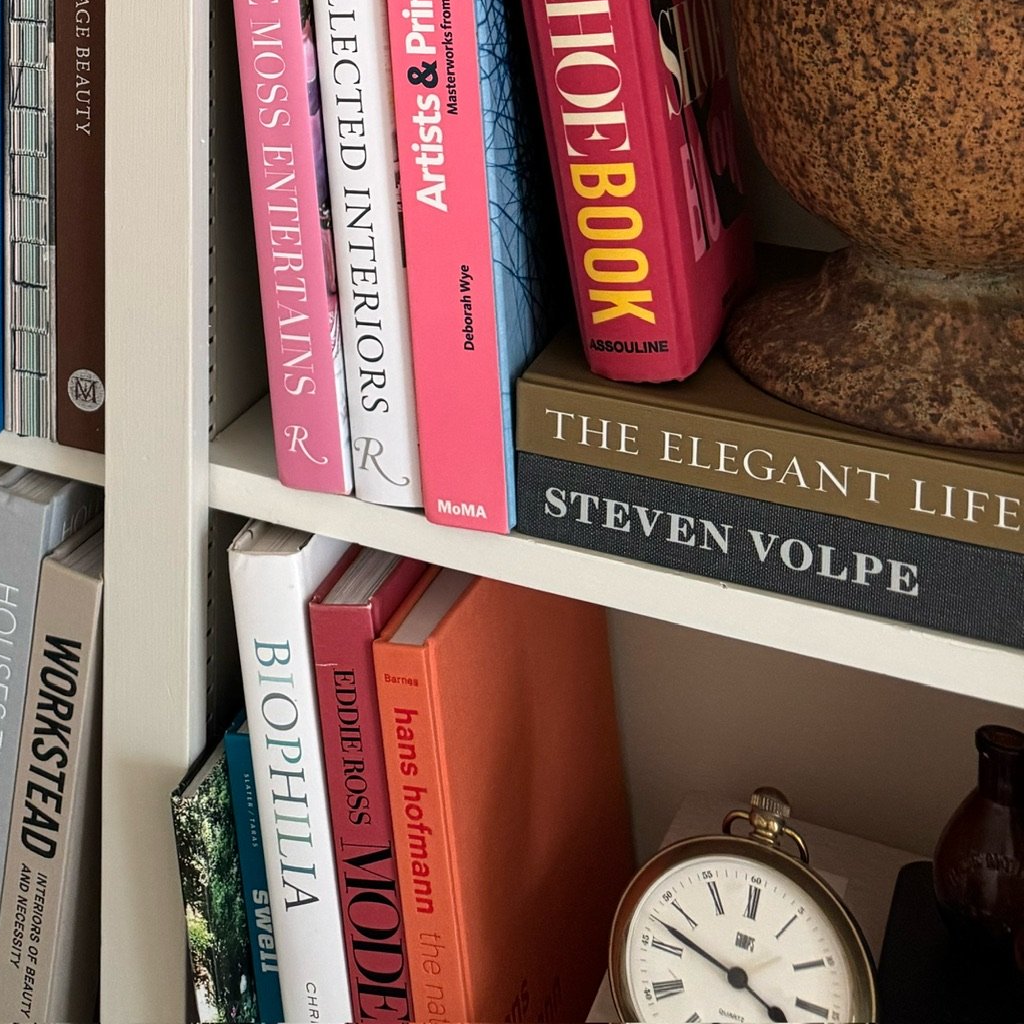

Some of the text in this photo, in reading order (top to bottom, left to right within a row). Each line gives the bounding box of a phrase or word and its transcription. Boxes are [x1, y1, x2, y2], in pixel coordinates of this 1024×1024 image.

[75, 46, 92, 136] BEAUTY
[249, 18, 292, 130] MOSS
[407, 59, 439, 89] &
[440, 31, 459, 116] Masterworks
[410, 92, 449, 213] Artists
[261, 143, 318, 397] ENTERTAINS
[569, 162, 657, 325] BOOK
[342, 186, 390, 415] INTERIORS
[459, 264, 475, 351] Deborah Wye
[589, 339, 669, 354] ASSOULINE
[437, 498, 487, 519] MoMA
[545, 408, 1021, 532] THE ELEGANT LIFE
[543, 486, 920, 597] STEVEN VOLPE
[383, 672, 419, 688] Barnes
[21, 634, 82, 860] WORKSTEAD
[243, 772, 254, 808] SLATER
[254, 637, 320, 913] BIOPHILIA
[332, 667, 372, 826] EDDIE ROSS
[393, 706, 447, 976] hans hofmann the
[750, 875, 762, 885] 60
[10, 862, 32, 970] AND NECESSITY
[20, 871, 48, 1019] INTERIORS OF BEAUTY
[252, 888, 280, 974] swell
